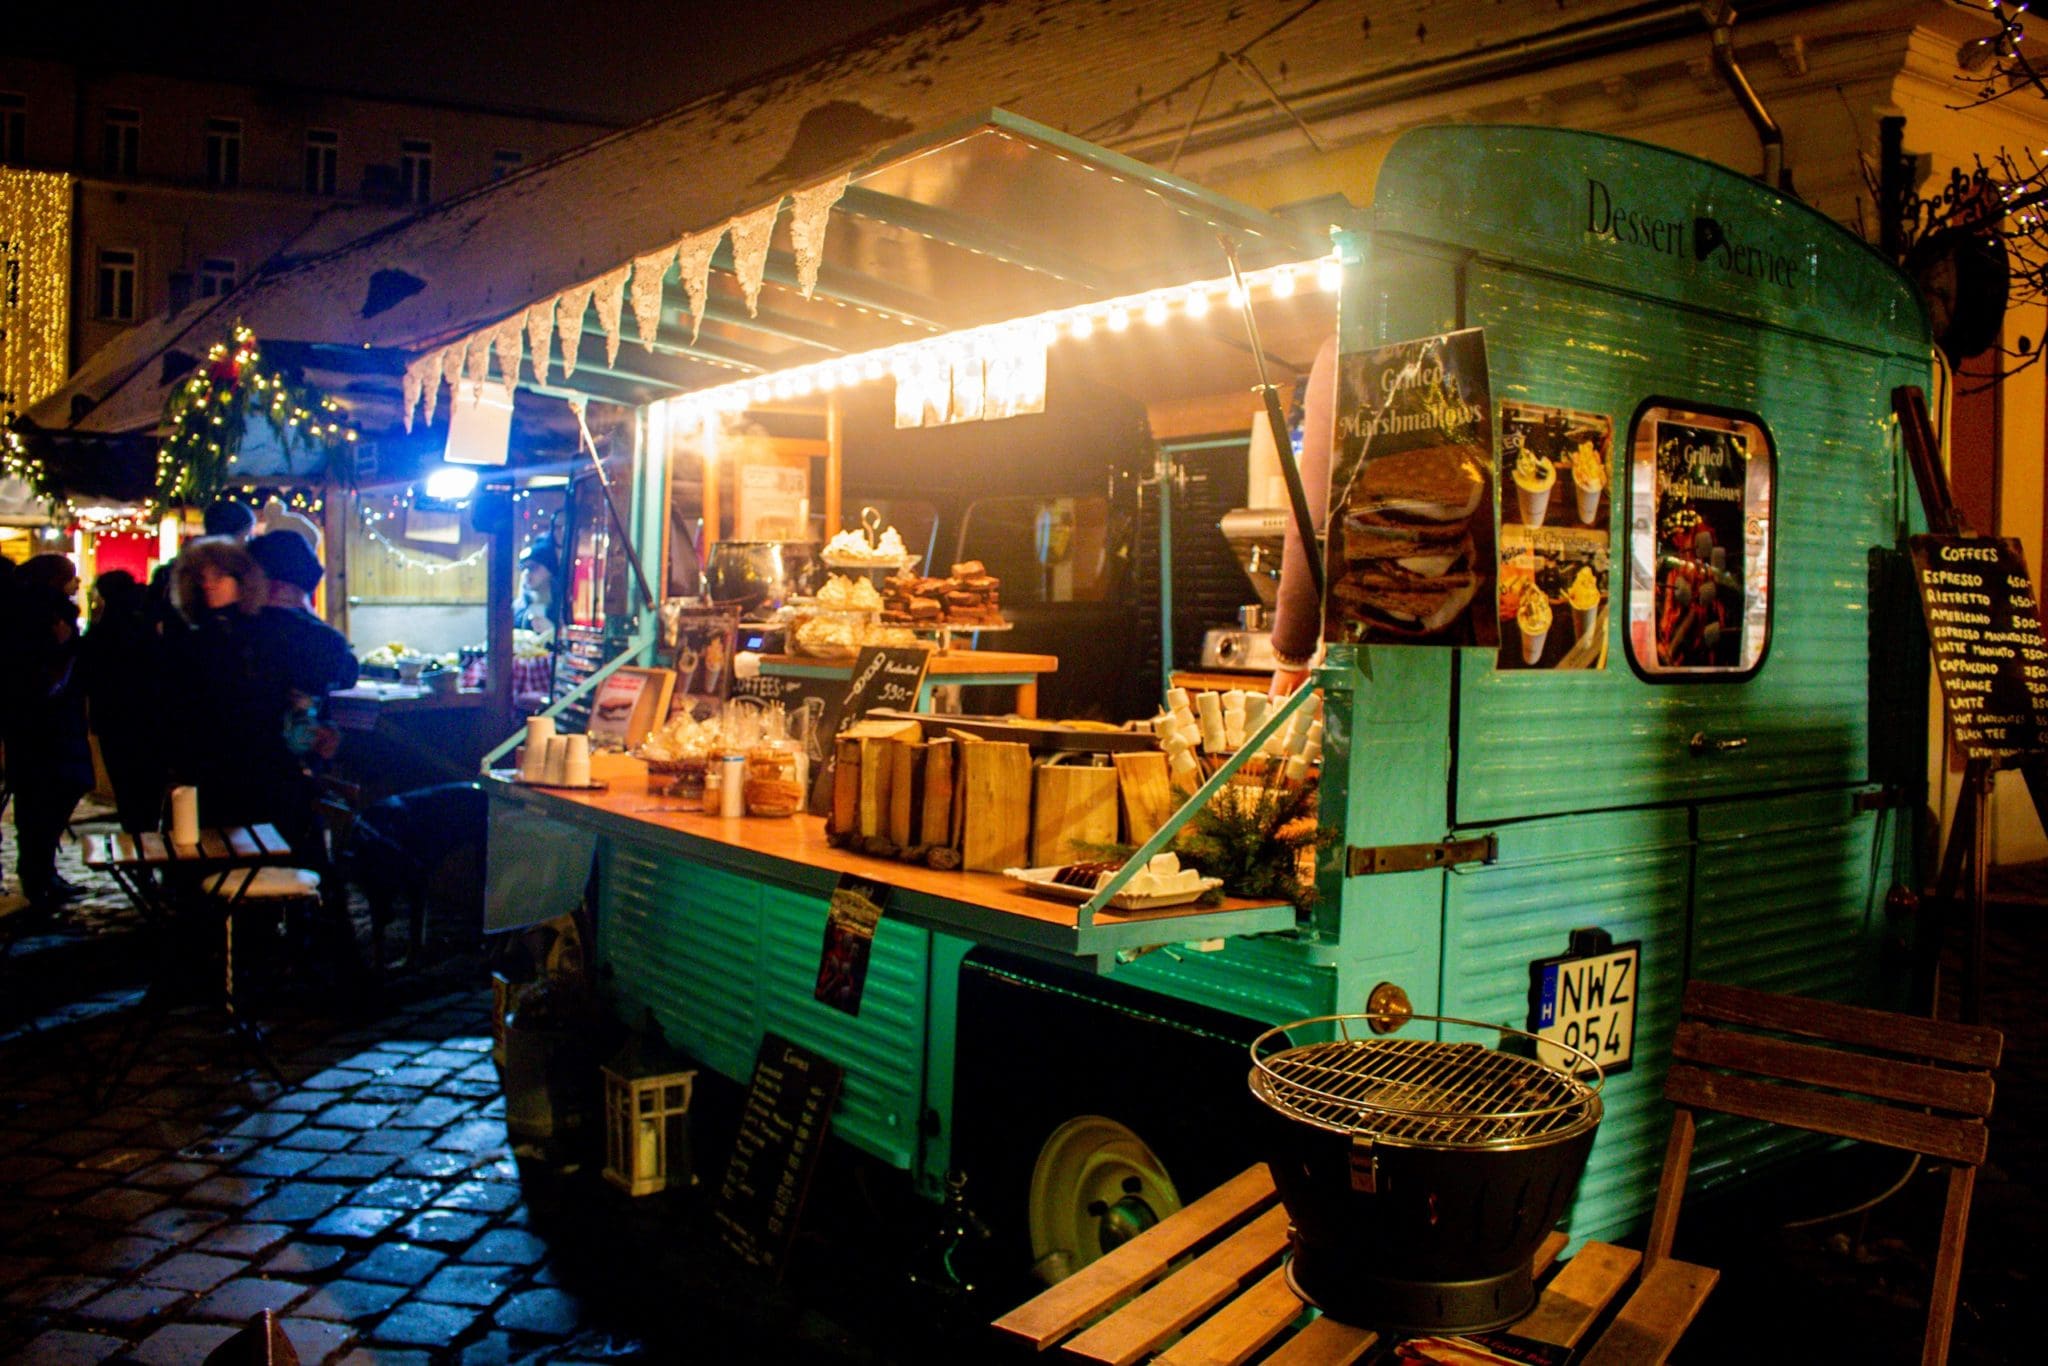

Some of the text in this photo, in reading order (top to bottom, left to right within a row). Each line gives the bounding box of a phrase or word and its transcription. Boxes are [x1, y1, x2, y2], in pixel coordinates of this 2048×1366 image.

[1587, 178, 1799, 289] Dessert Service
[1338, 403, 1482, 439] Marshmallows
[1683, 444, 1725, 473] Grilled
[1940, 546, 1999, 562] COFFEES
[1922, 570, 1983, 587] ESPRESSO
[1926, 588, 1991, 606] RISTRETTO
[1930, 608, 1991, 625] AMERICANO
[1934, 626, 1980, 641] ESPRESSO
[1937, 641, 1967, 654] LATTE
[1939, 659, 1999, 675] CAPPUCCINO
[1950, 696, 1985, 710] LATTE
[1953, 713, 1974, 725] HOT
[1955, 728, 1982, 741] BLACK
[1560, 957, 1632, 1018] NWZ
[1541, 1003, 1553, 1021] H
[1563, 1011, 1621, 1068] 954
